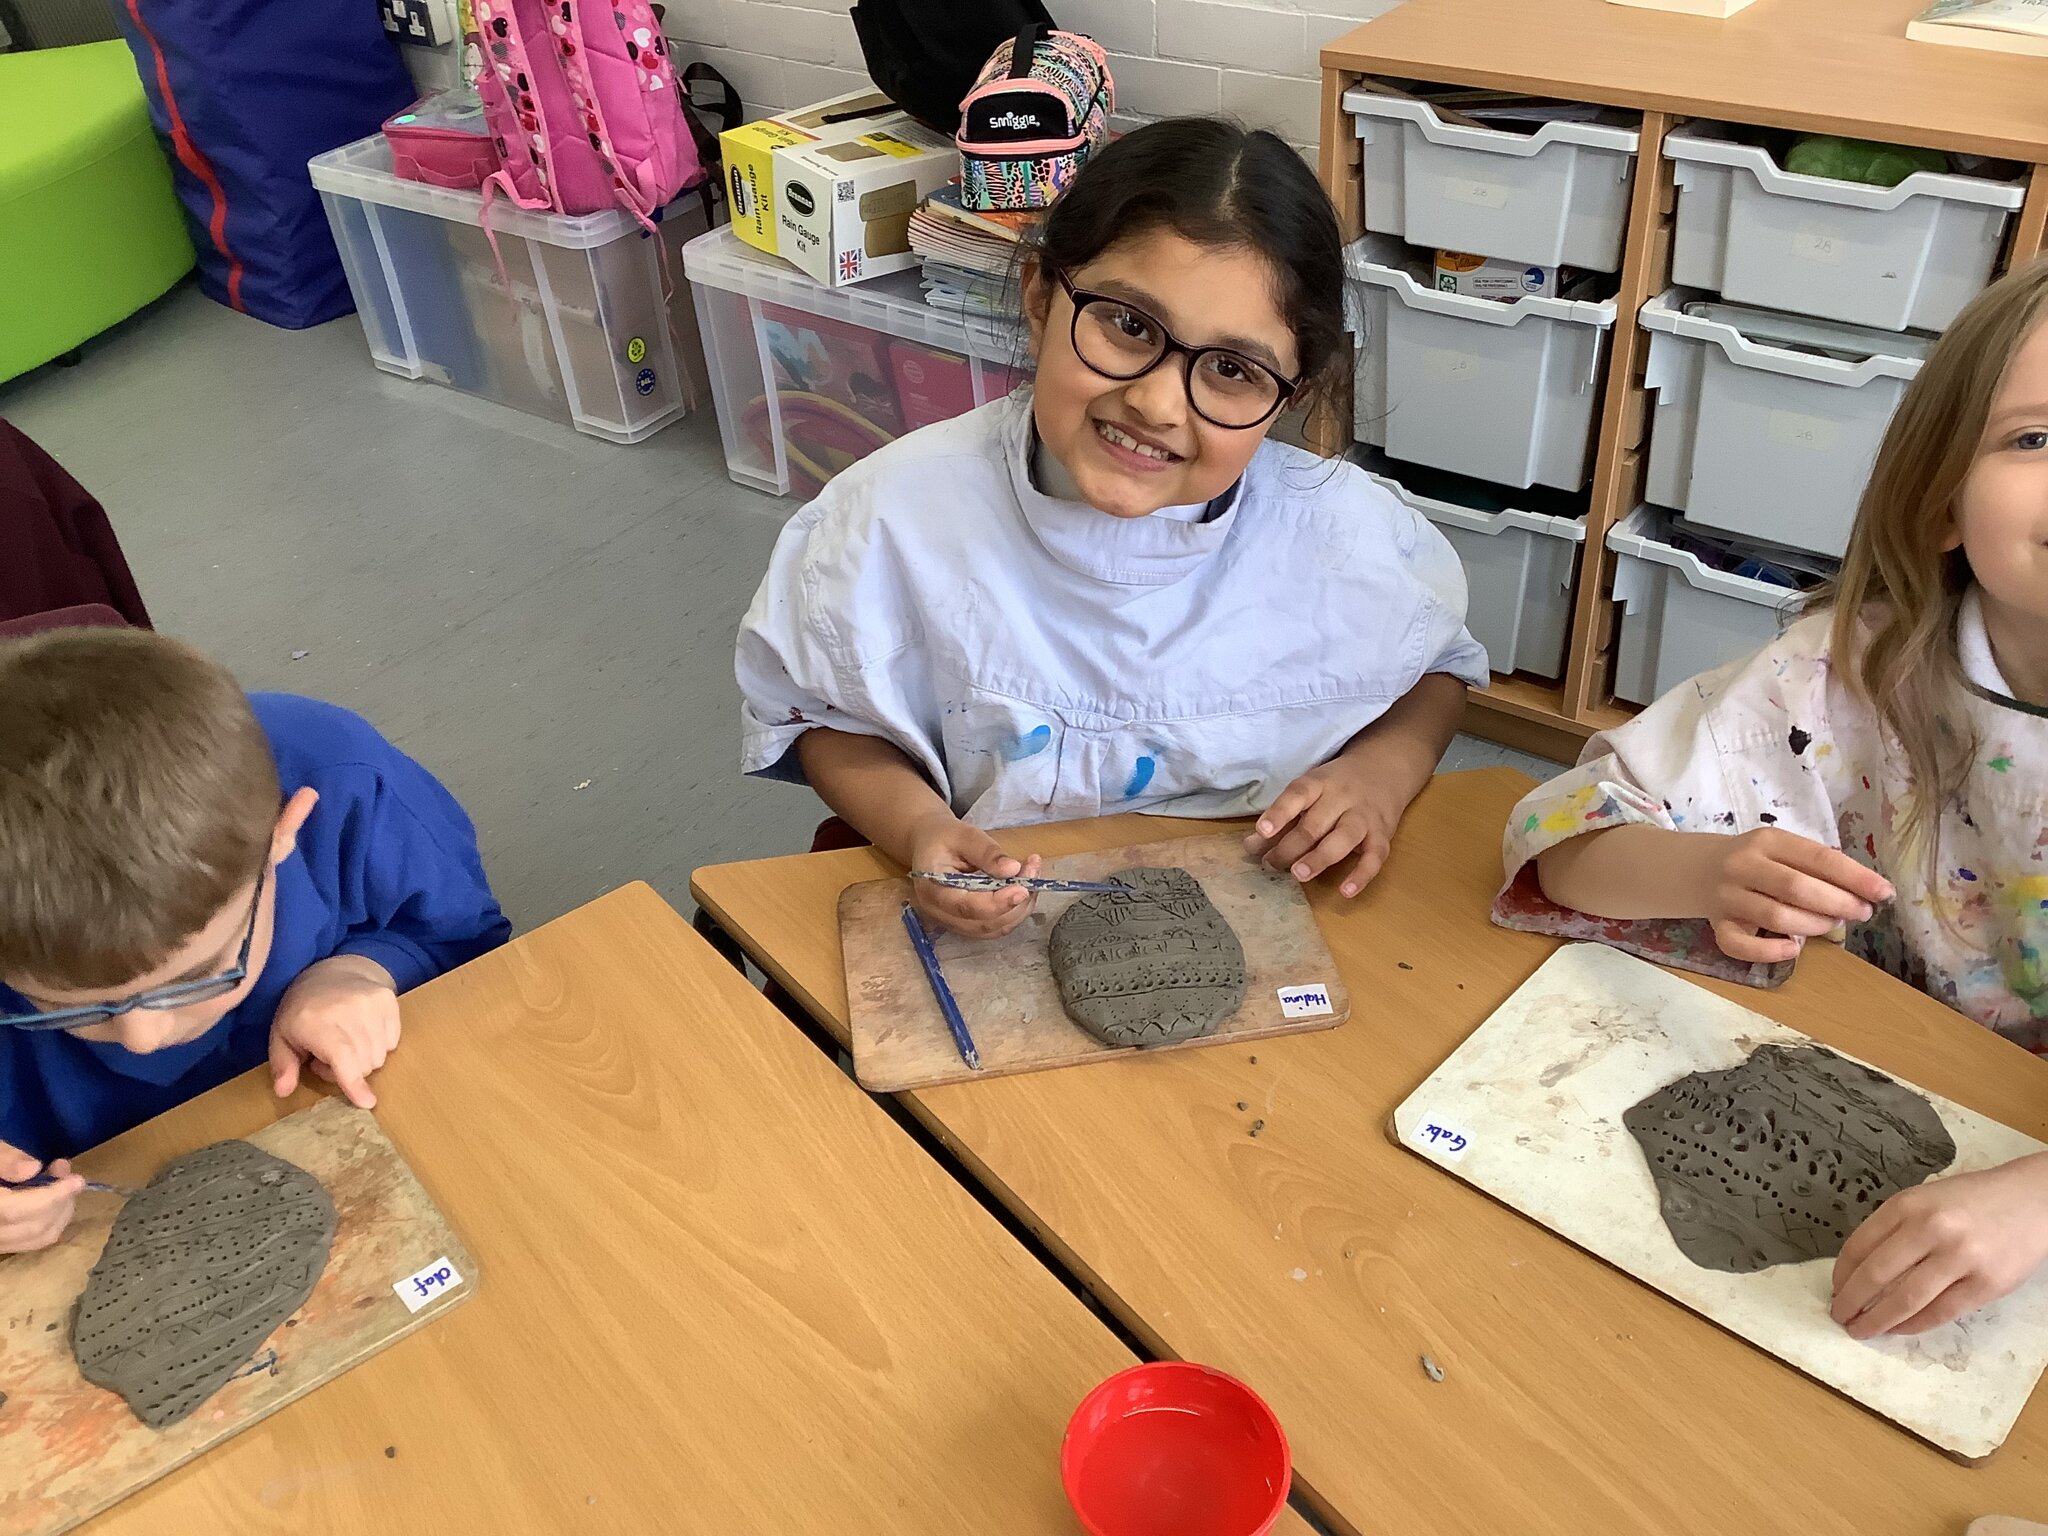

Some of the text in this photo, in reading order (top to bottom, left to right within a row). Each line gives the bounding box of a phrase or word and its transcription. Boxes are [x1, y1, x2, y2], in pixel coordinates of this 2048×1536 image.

[748, 164, 764, 235] Rain Gauge
[760, 194, 769, 212] Kit
[787, 187, 813, 209] Brannan
[781, 214, 820, 246] Rain Gauge
[796, 239, 807, 253] Kit
[1421, 1123, 1467, 1152] Gabi
